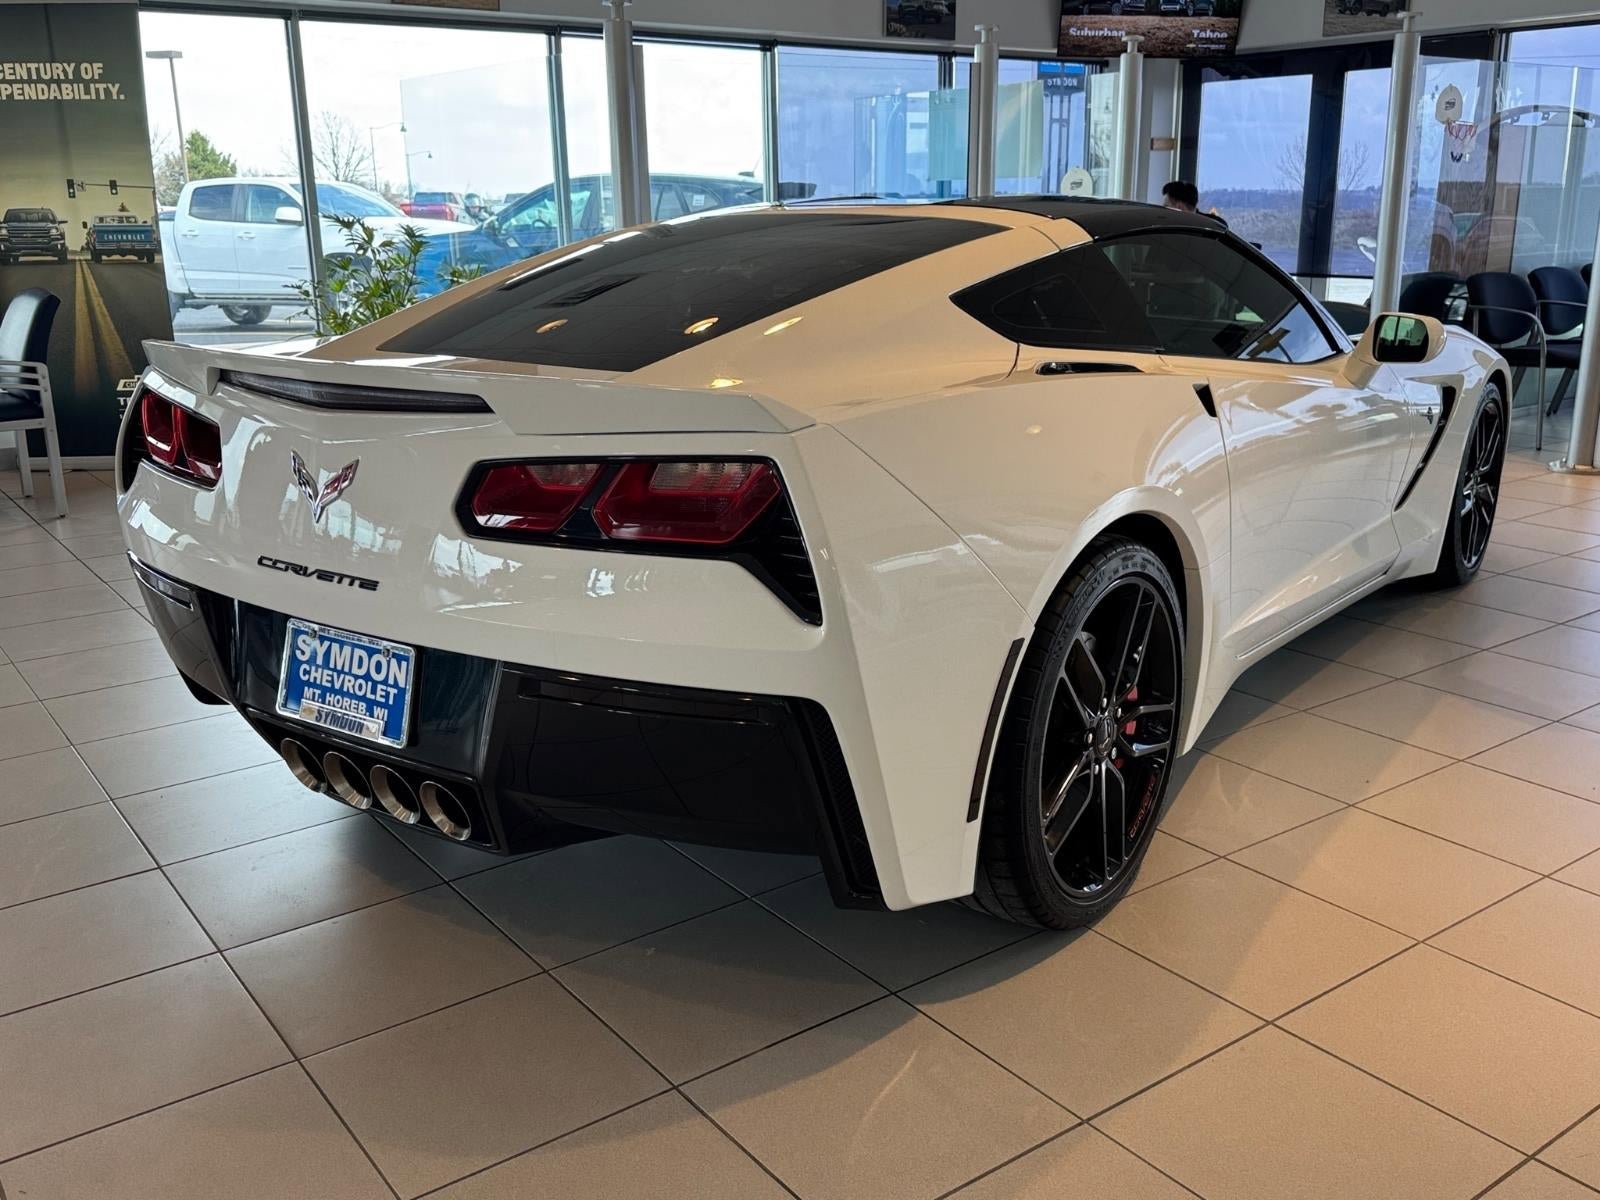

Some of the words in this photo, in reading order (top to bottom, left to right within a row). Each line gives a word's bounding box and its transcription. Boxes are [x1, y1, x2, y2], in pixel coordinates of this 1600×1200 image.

[80, 63, 103, 79] OF
[257, 555, 380, 592] CORVETTE
[295, 633, 408, 689] SYMDON
[299, 663, 398, 705] CHEVROLET
[303, 686, 322, 702] MT.
[374, 705, 388, 722] WI
